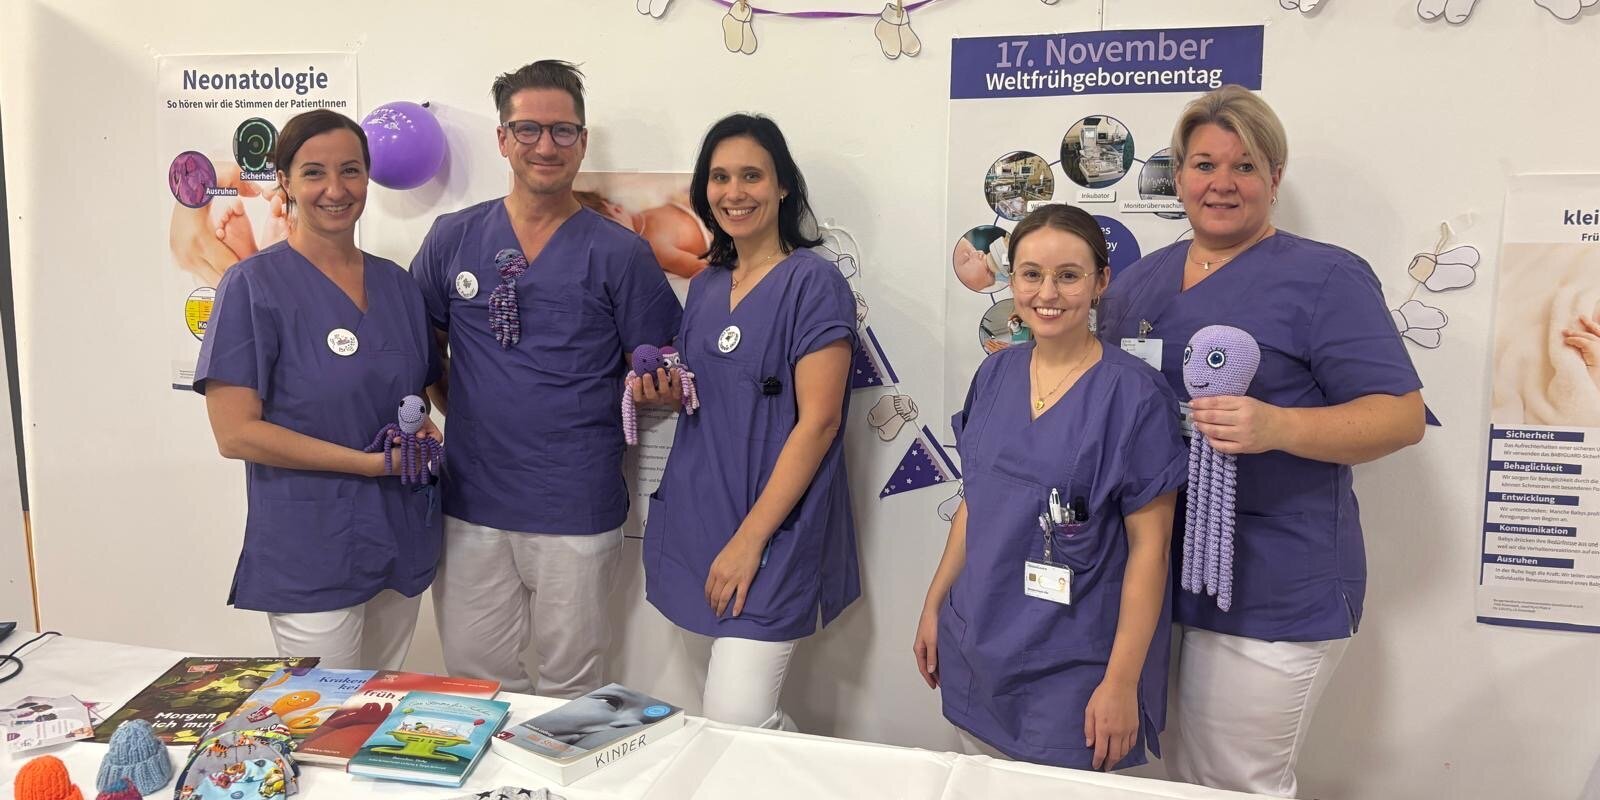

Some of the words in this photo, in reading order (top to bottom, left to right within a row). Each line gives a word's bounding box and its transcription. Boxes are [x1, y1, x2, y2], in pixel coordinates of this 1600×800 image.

[996, 40, 1034, 68] 17.
[1045, 32, 1214, 66] November
[183, 66, 329, 95] Neonatologie
[985, 65, 1223, 92] Weltfrühgeborenentag
[167, 100, 177, 108] So
[179, 99, 203, 108] hören
[205, 99, 218, 108] wir
[220, 98, 233, 108] die
[235, 98, 273, 108] Stimmen
[274, 98, 289, 108] der
[290, 98, 347, 108] PatientInnen
[240, 172, 276, 180] Sicherheit
[1505, 430, 1555, 440] Sicherheit
[1503, 462, 1563, 472] Behaglichkeit
[1501, 493, 1556, 504] Entwicklung
[1499, 524, 1569, 535] Kommunikation
[1496, 555, 1538, 565] Ausruhen
[319, 676, 367, 684] Kraken
[363, 689, 396, 699] früh
[154, 712, 217, 722] Morgen
[594, 733, 647, 768] KINDER
